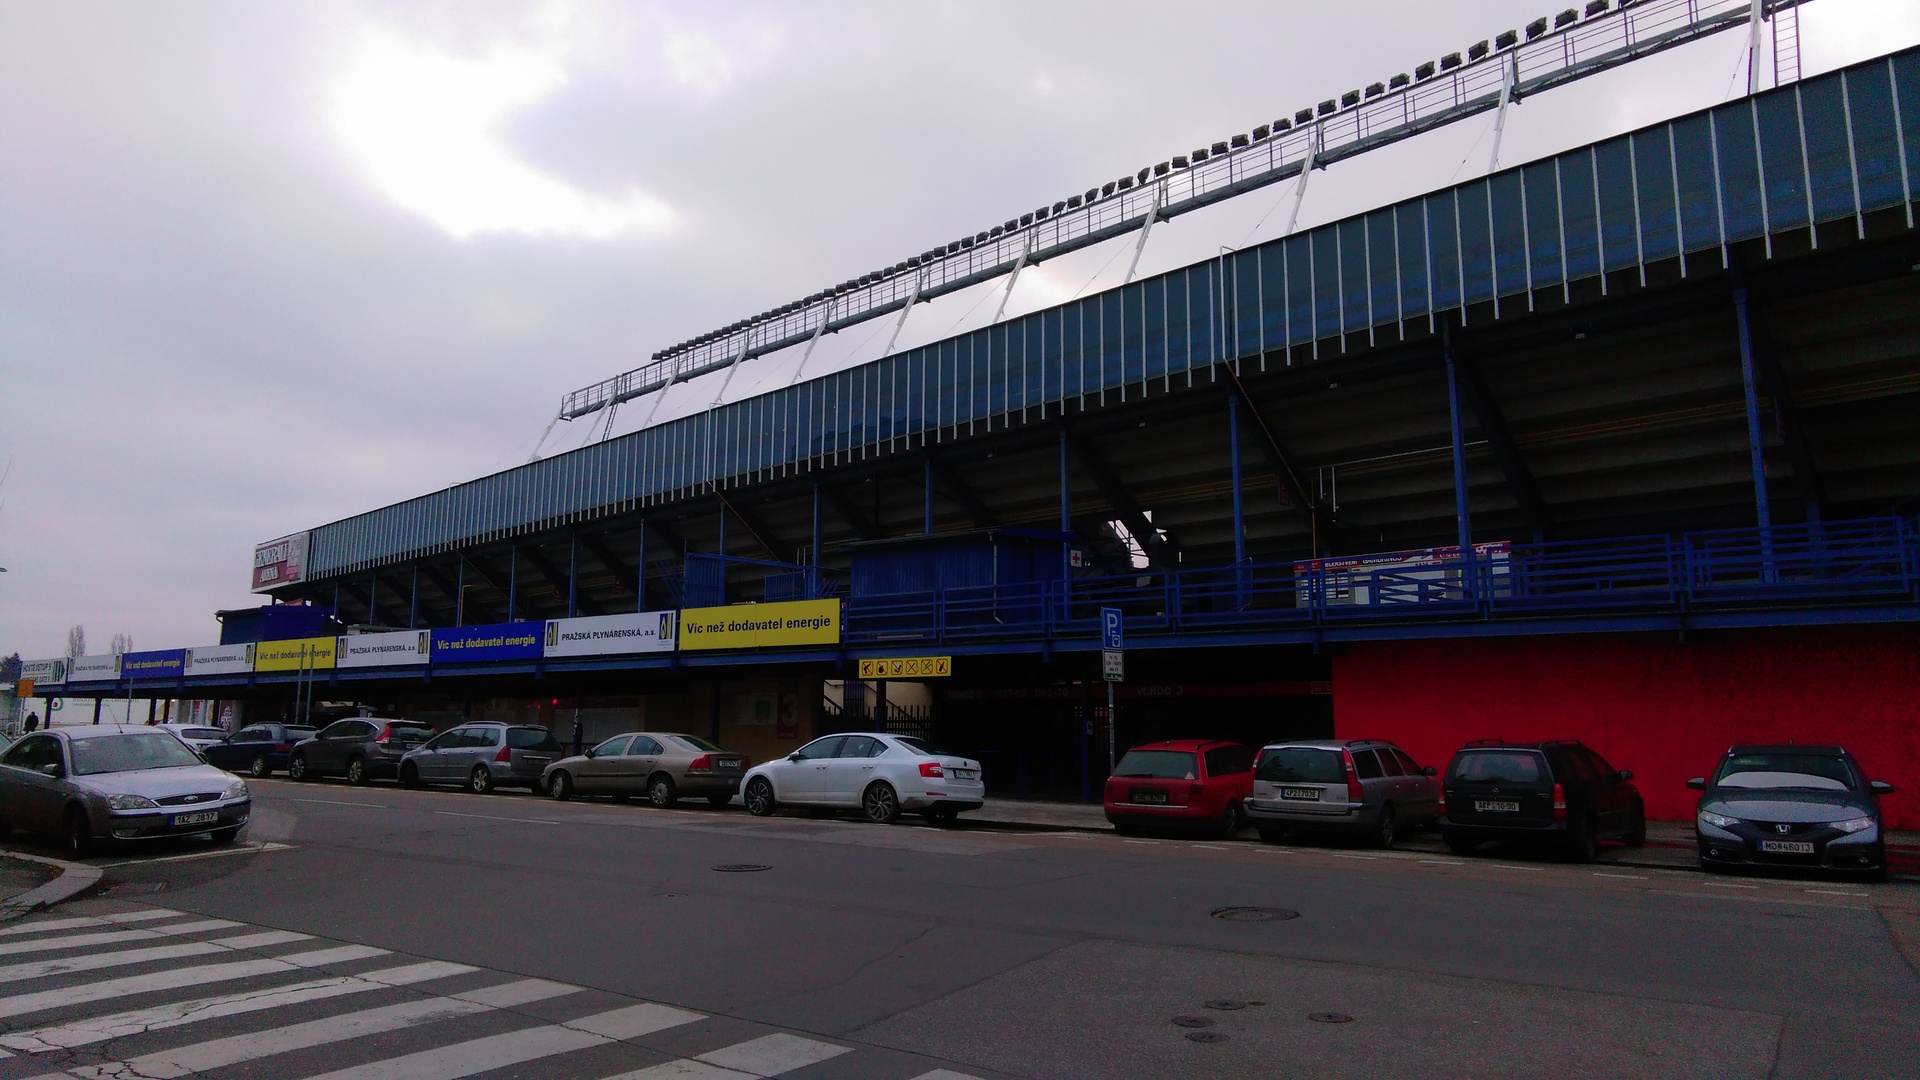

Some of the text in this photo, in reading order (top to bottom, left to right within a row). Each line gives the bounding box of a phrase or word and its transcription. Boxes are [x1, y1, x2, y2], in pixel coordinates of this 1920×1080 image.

[706, 621, 725, 633] než
[728, 618, 783, 632] dodavatel
[786, 615, 831, 630] energie
[1106, 613, 1118, 637] P
[450, 638, 465, 649] než
[466, 635, 504, 648] dodavatel
[505, 634, 536, 647] energie
[1137, 686, 1184, 696] VCHOD 3
[782, 693, 799, 728] 3
[1479, 801, 1491, 809] AKP
[178, 815, 190, 823] 1AZ
[1765, 842, 1777, 850] MD
